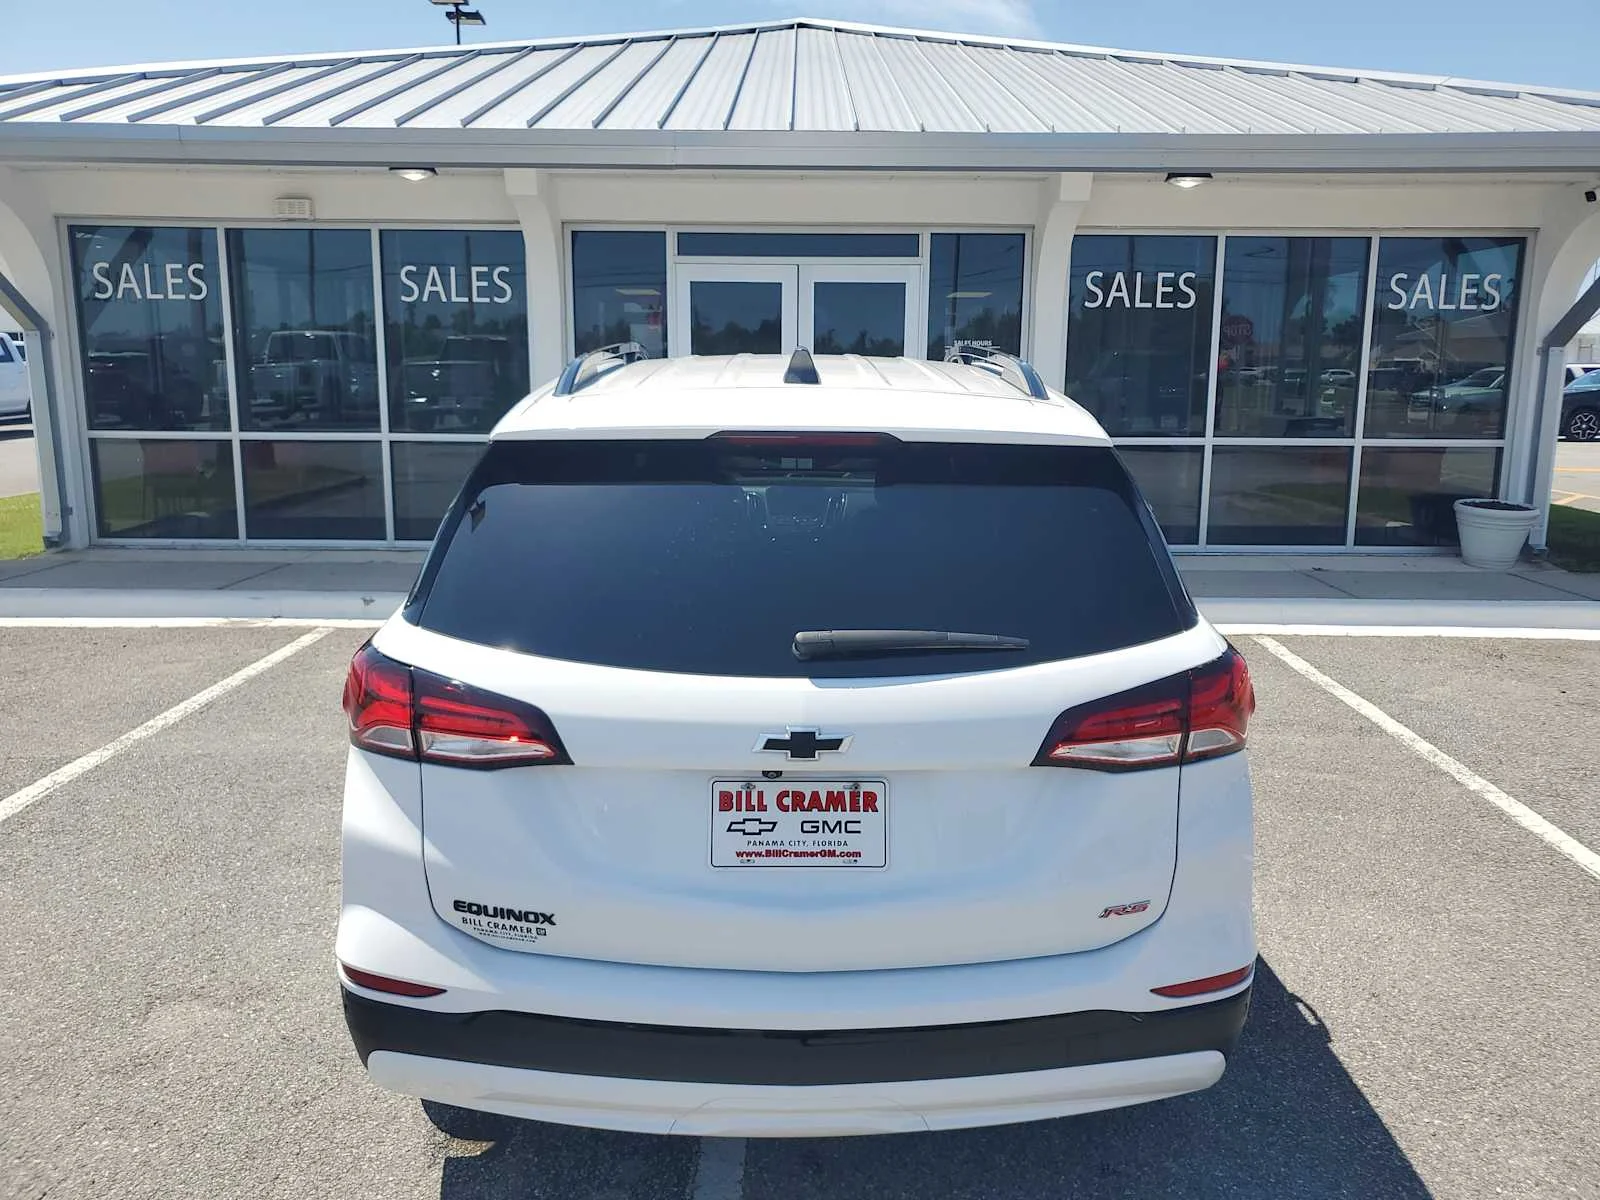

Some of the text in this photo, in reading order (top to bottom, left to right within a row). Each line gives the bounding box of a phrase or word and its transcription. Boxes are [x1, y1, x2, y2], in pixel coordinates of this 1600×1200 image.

[92, 262, 208, 301] SALES
[400, 265, 513, 304] SALES
[1084, 271, 1197, 309] SALES
[1387, 272, 1502, 311] SALES
[719, 790, 879, 812] BILL CRAMER
[801, 820, 861, 834] GMC
[736, 850, 861, 858] www.BillCramerGM.com
[788, 840, 808, 848] CITY,
[453, 899, 557, 926] EQUINOX
[1098, 899, 1151, 919] RS
[462, 916, 483, 927] BILL
[487, 921, 533, 935] CRAMER
